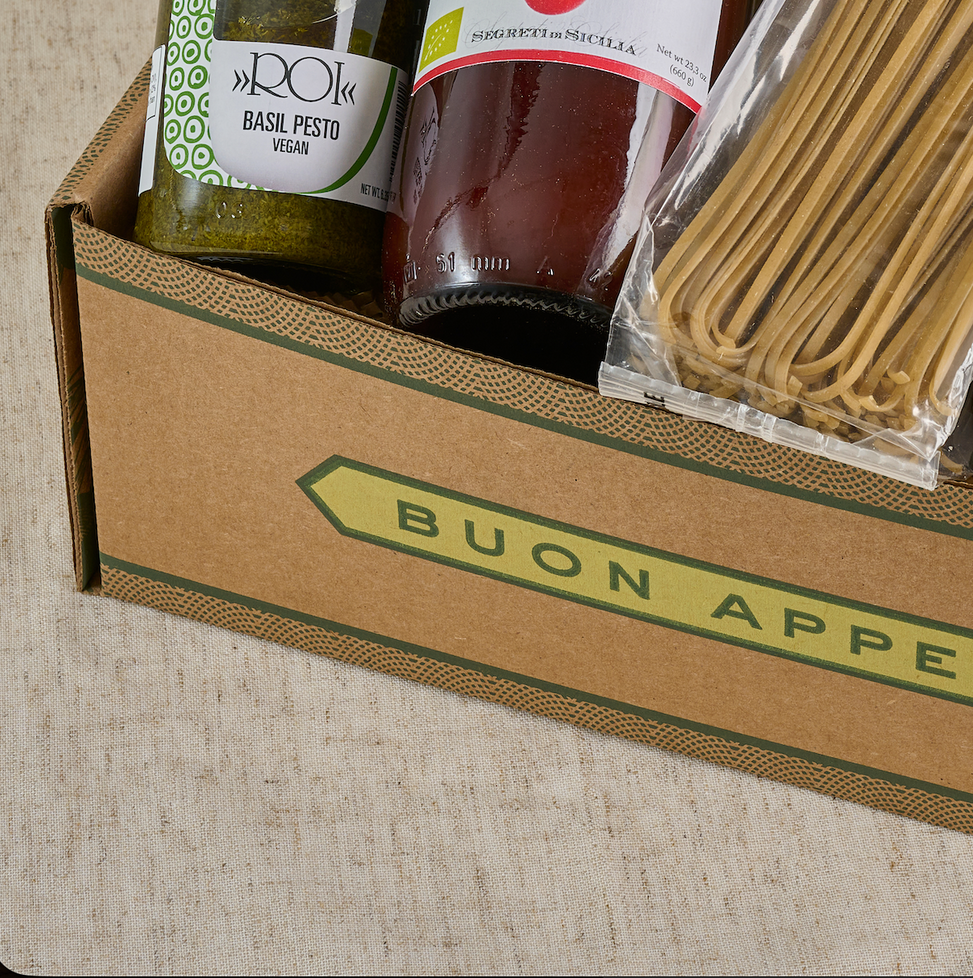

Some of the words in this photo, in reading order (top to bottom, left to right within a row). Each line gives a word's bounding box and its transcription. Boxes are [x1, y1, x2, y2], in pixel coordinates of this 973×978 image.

[470, 28, 548, 43] SEGRETI
[564, 28, 637, 56] SICILIA
[243, 110, 287, 133] BASIL
[294, 115, 340, 140] PESTO
[273, 138, 309, 155] VEGAN
[471, 255, 511, 272] mm
[398, 499, 650, 601] BUON
